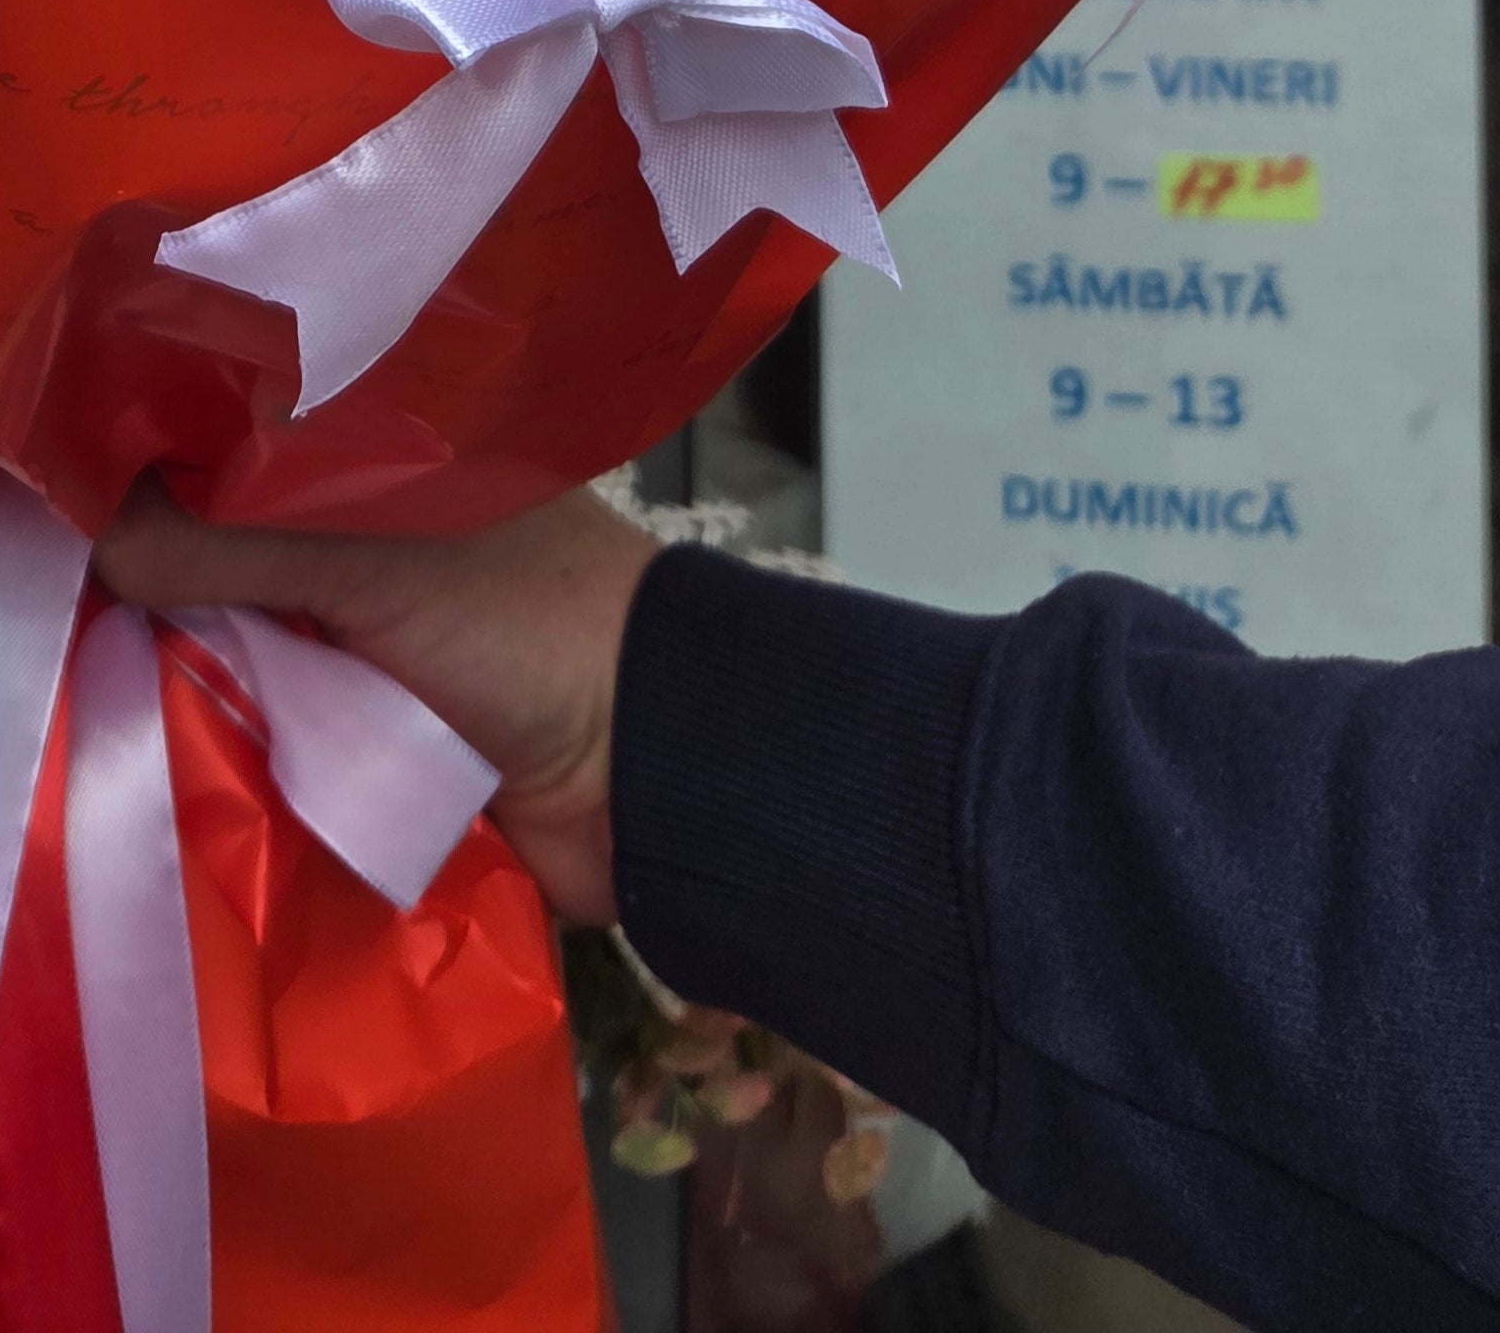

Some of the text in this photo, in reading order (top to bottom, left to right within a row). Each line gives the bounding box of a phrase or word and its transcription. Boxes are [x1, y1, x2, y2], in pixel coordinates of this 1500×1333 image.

[1147, 53, 1341, 109] VINERI
[1049, 151, 1087, 207] 9
[1050, 365, 1088, 420] 9
[1168, 373, 1244, 428] 13
[1002, 473, 1299, 538] DUMINICĂ
